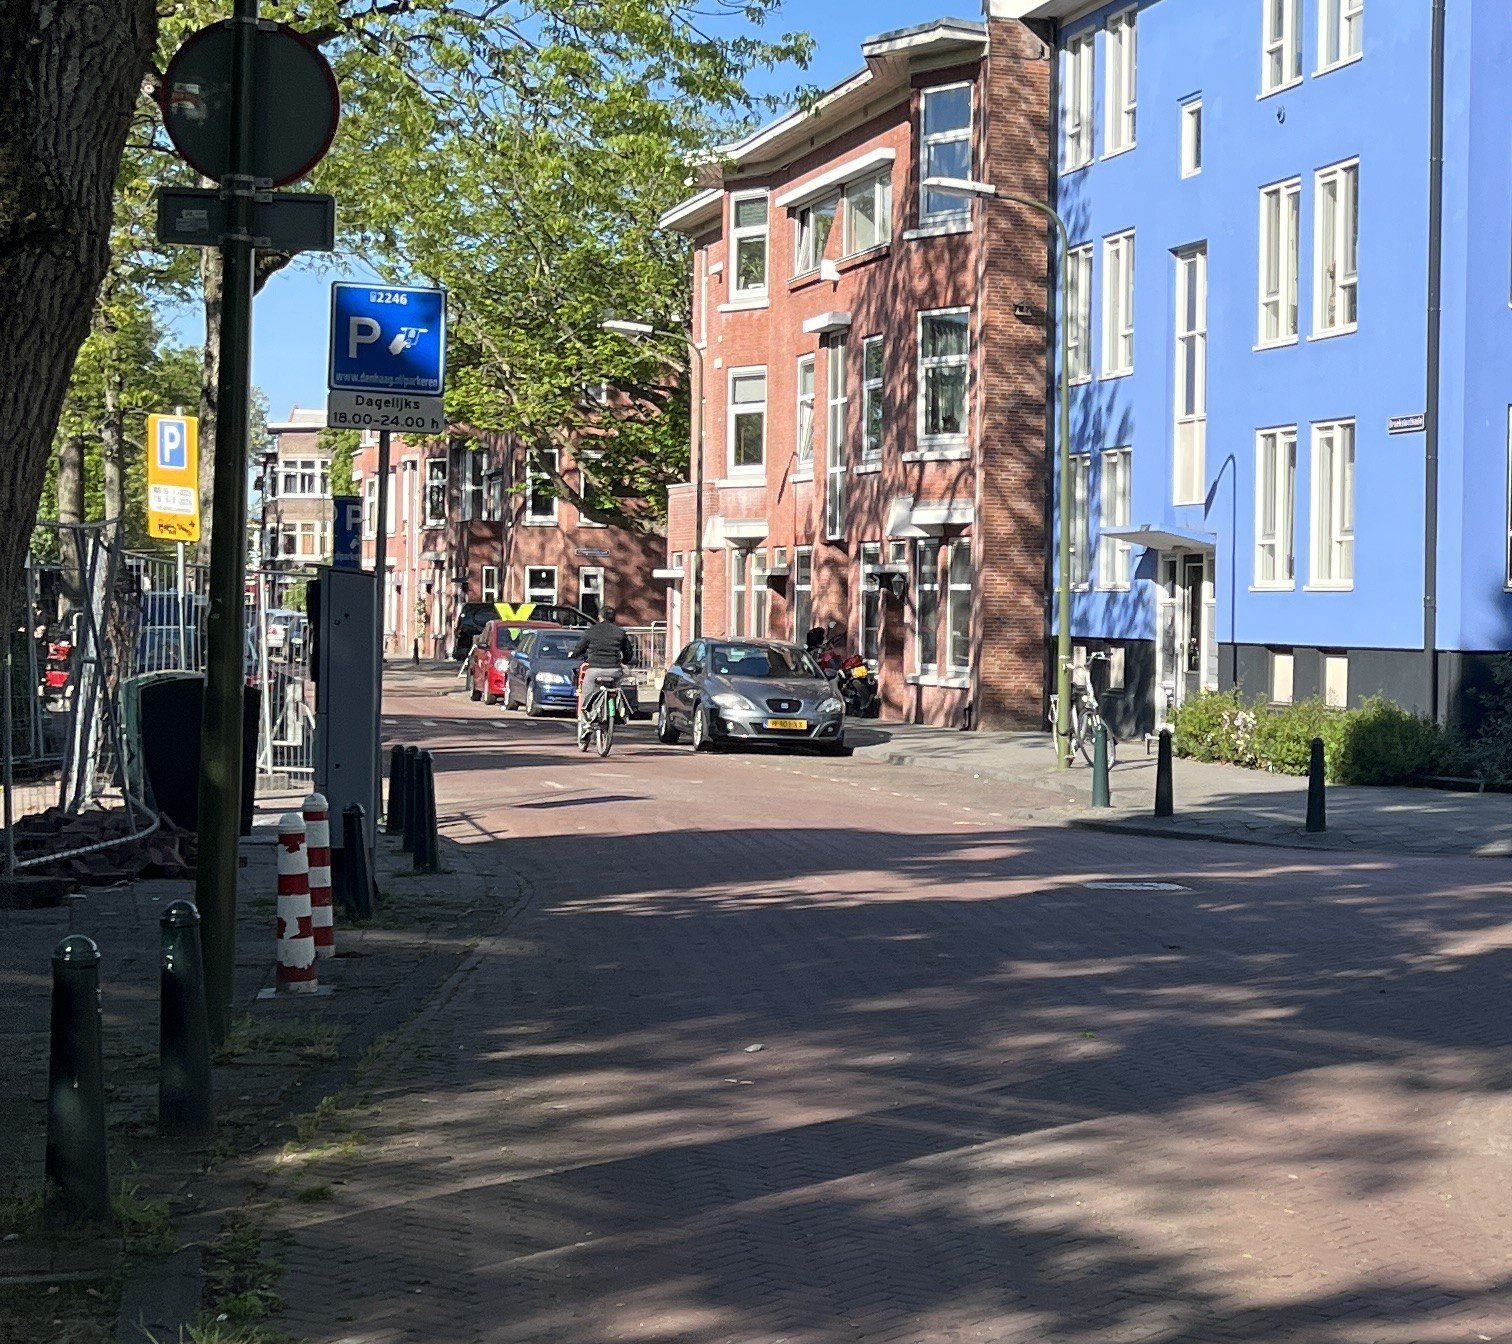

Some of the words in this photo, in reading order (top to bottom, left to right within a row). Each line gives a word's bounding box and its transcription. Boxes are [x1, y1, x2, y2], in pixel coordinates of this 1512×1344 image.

[349, 316, 381, 358] P
[355, 394, 420, 412] Dagelijks
[333, 412, 425, 429] 18.00-24.00
[430, 418, 440, 430] h
[164, 425, 181, 463] P
